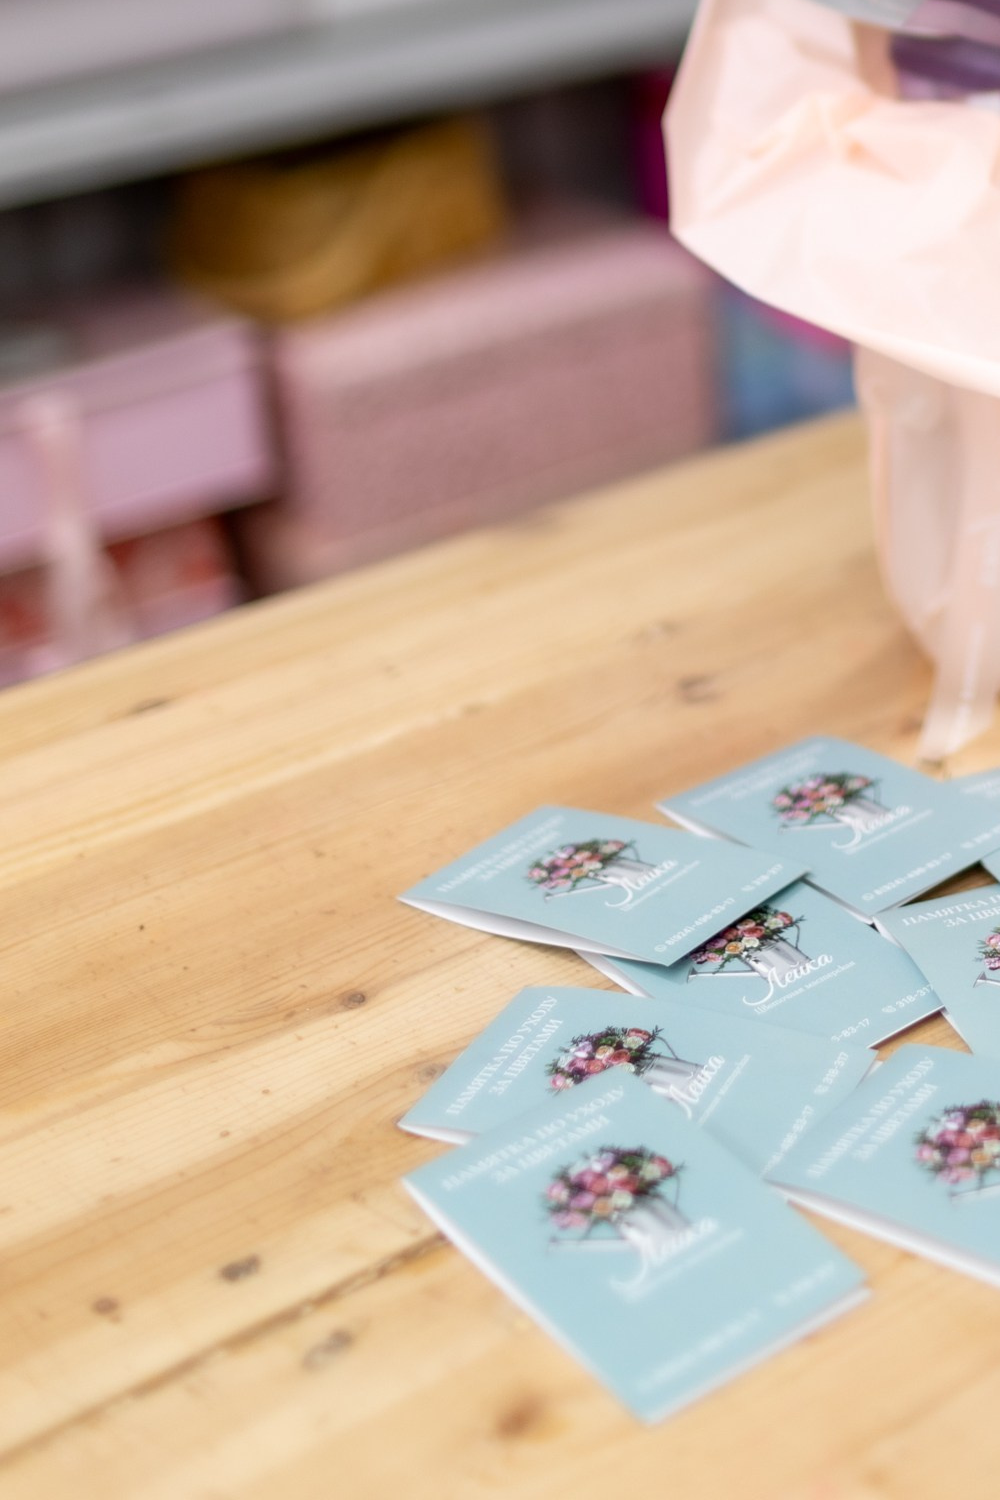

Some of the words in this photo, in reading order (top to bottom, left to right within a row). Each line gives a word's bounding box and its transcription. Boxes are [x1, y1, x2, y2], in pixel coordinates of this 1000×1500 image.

[902, 900, 989, 926] ПАМЯТКА
[943, 916, 968, 928] ЗА
[742, 953, 834, 1007] Лейка
[445, 1055, 508, 1116] ПАМЯТКА
[499, 1035, 525, 1055] ПО
[516, 995, 558, 1034] УХОДУ
[488, 1079, 513, 1097] ЗА
[503, 1018, 564, 1078] ЦВЕТАМИ
